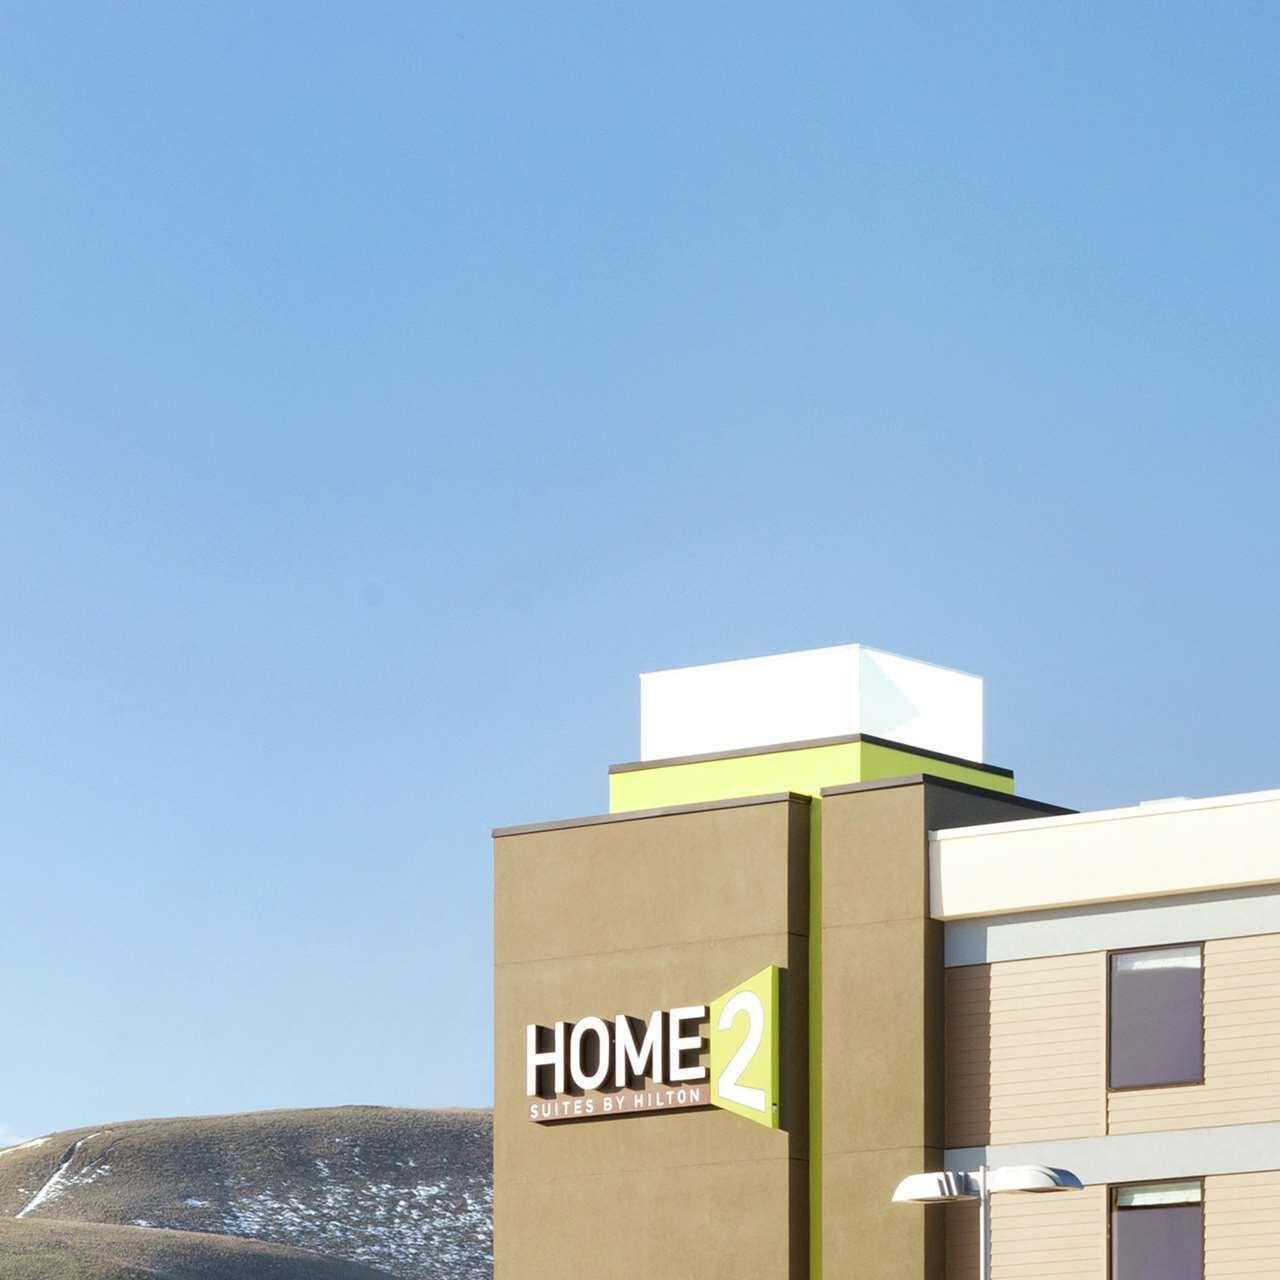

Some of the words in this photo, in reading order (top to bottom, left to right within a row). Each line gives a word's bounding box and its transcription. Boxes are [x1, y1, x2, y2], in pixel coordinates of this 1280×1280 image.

[526, 1005, 706, 1096] HOME
[717, 991, 766, 1113] 2
[530, 1099, 593, 1119] SUITES
[603, 1096, 625, 1111] BY
[634, 1088, 700, 1108] HILTON
